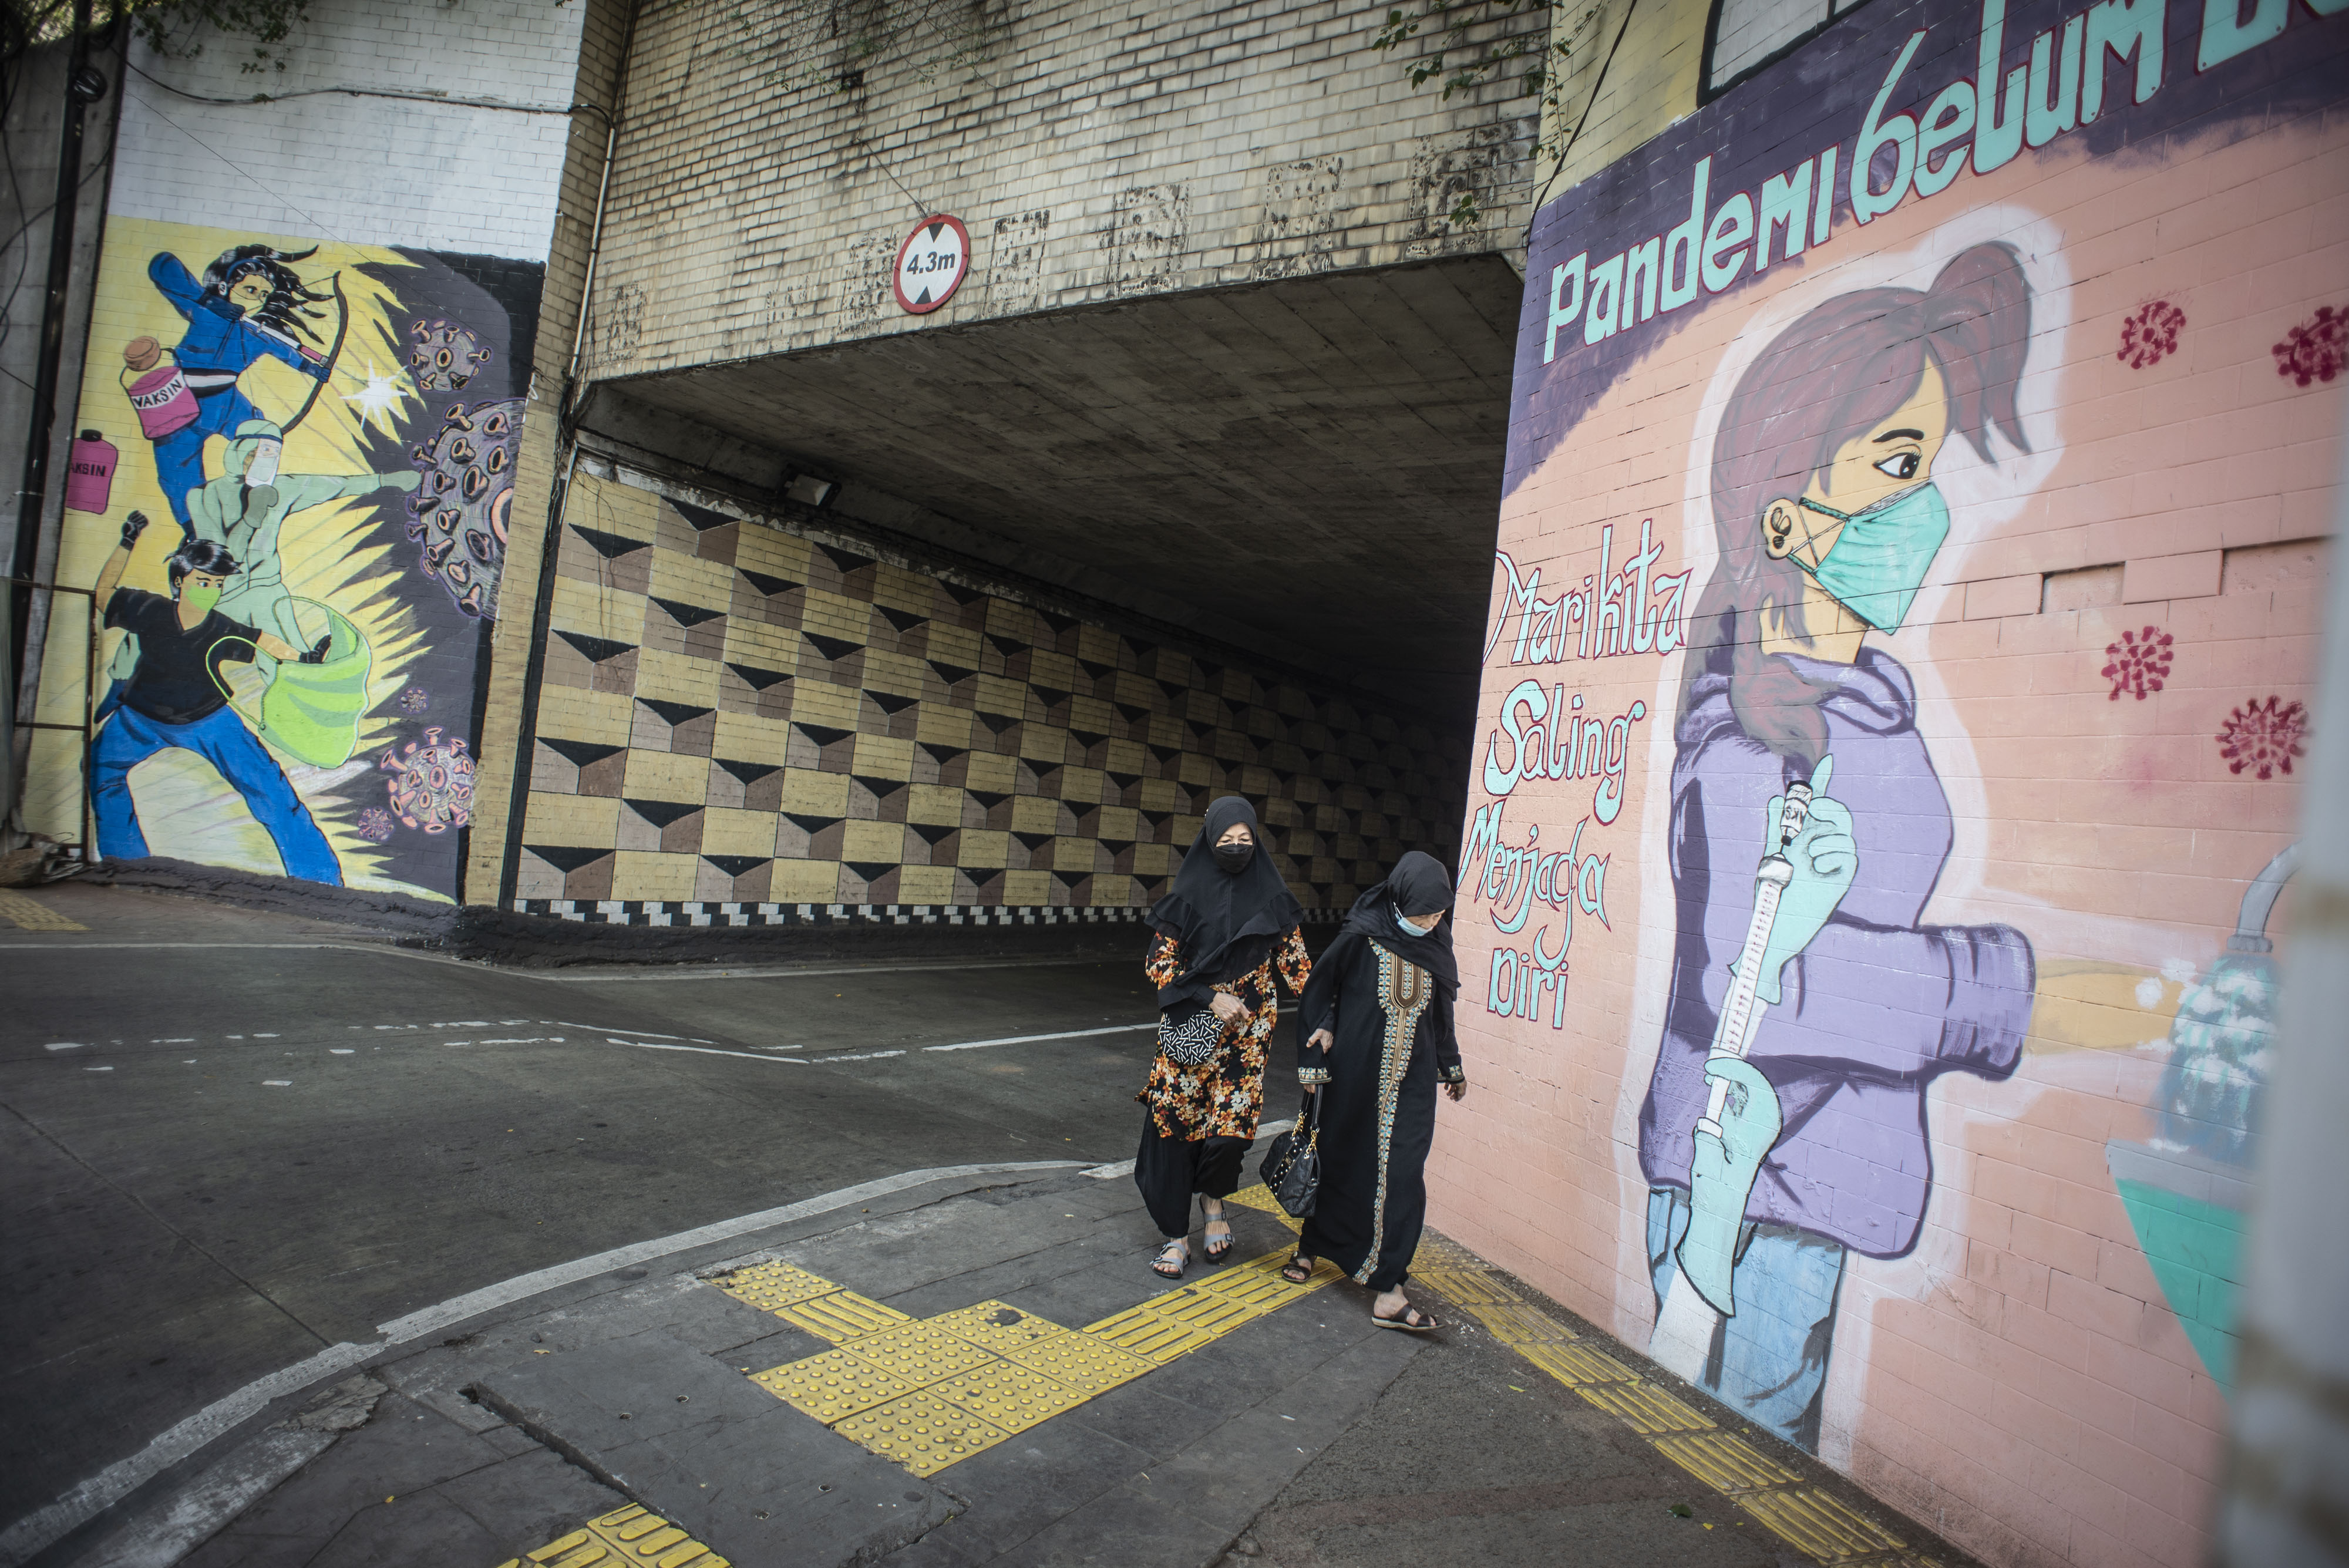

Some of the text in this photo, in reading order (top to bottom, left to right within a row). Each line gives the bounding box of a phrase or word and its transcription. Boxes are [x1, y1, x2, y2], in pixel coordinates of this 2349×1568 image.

[907, 251, 955, 275] 4.3m
[133, 379, 182, 408] VAKSIN
[1483, 679, 1646, 826] Saling
